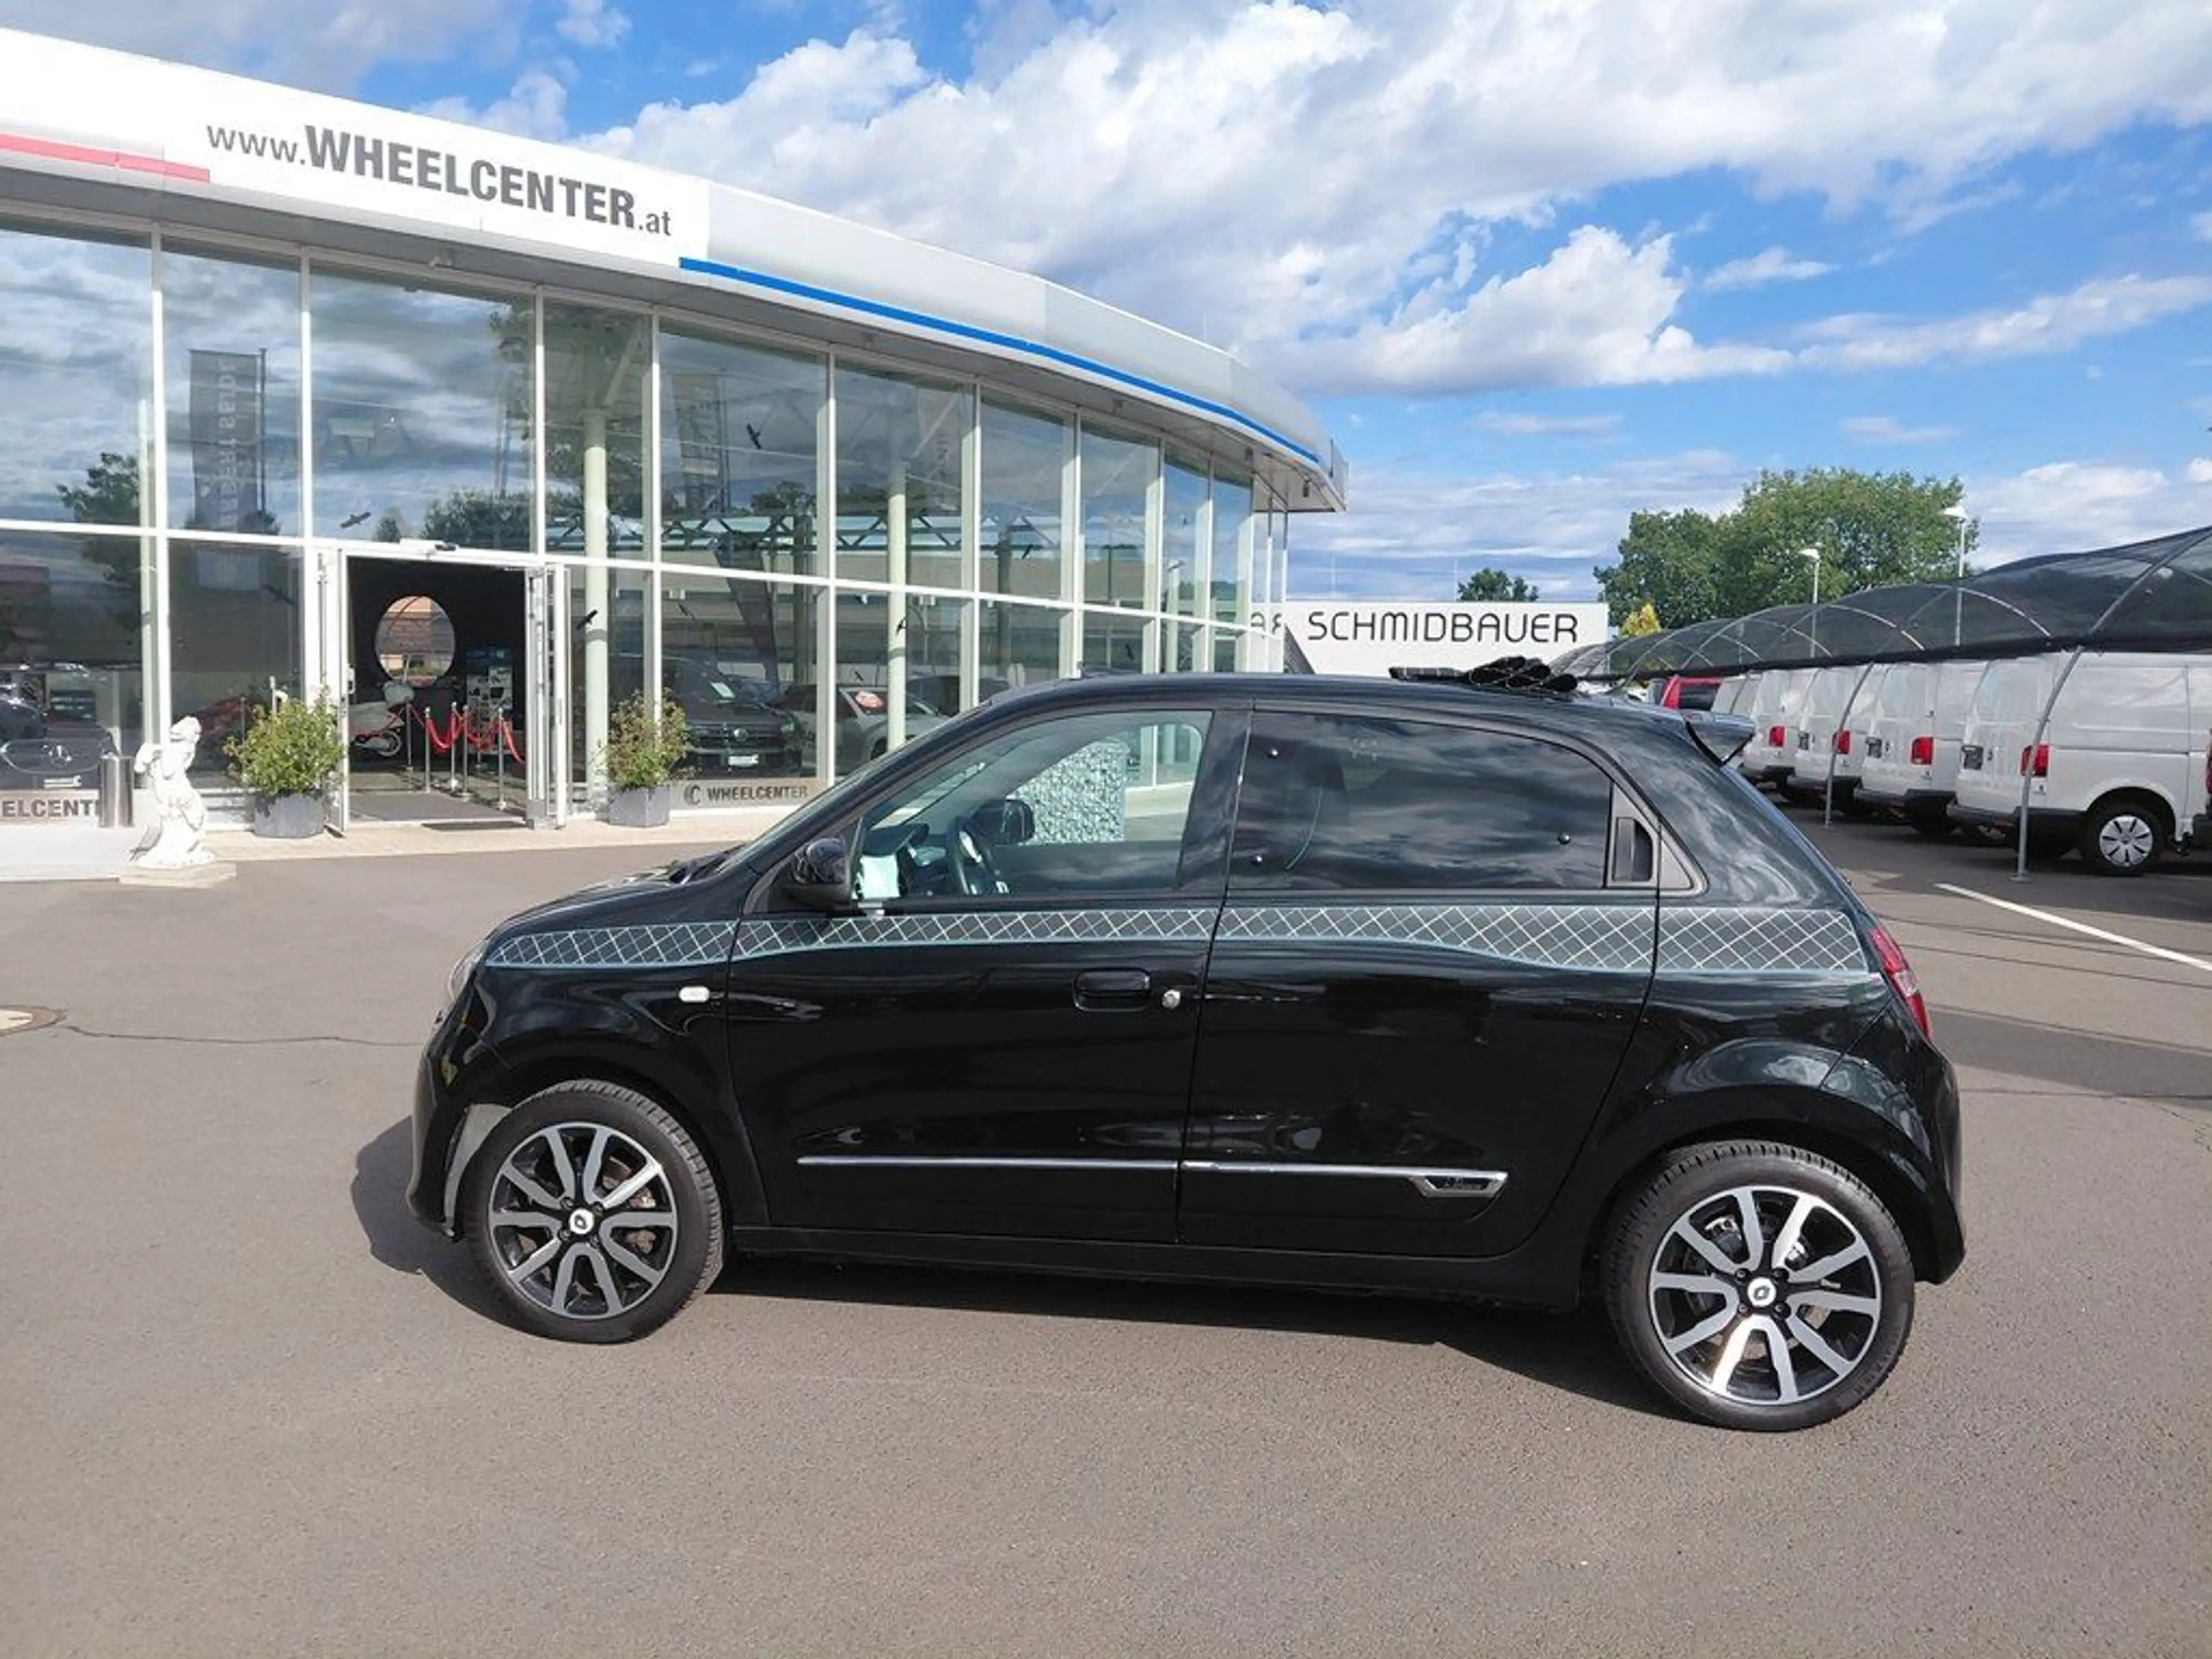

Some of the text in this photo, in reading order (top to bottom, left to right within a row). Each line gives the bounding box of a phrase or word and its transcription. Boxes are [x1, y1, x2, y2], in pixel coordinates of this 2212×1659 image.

[207, 125, 671, 236] www.WHEELCENTER.at
[1308, 611, 1578, 643] SCHMIDBAUER
[706, 785, 808, 801] WHEELCENTER
[2, 799, 99, 817] ELCENT
